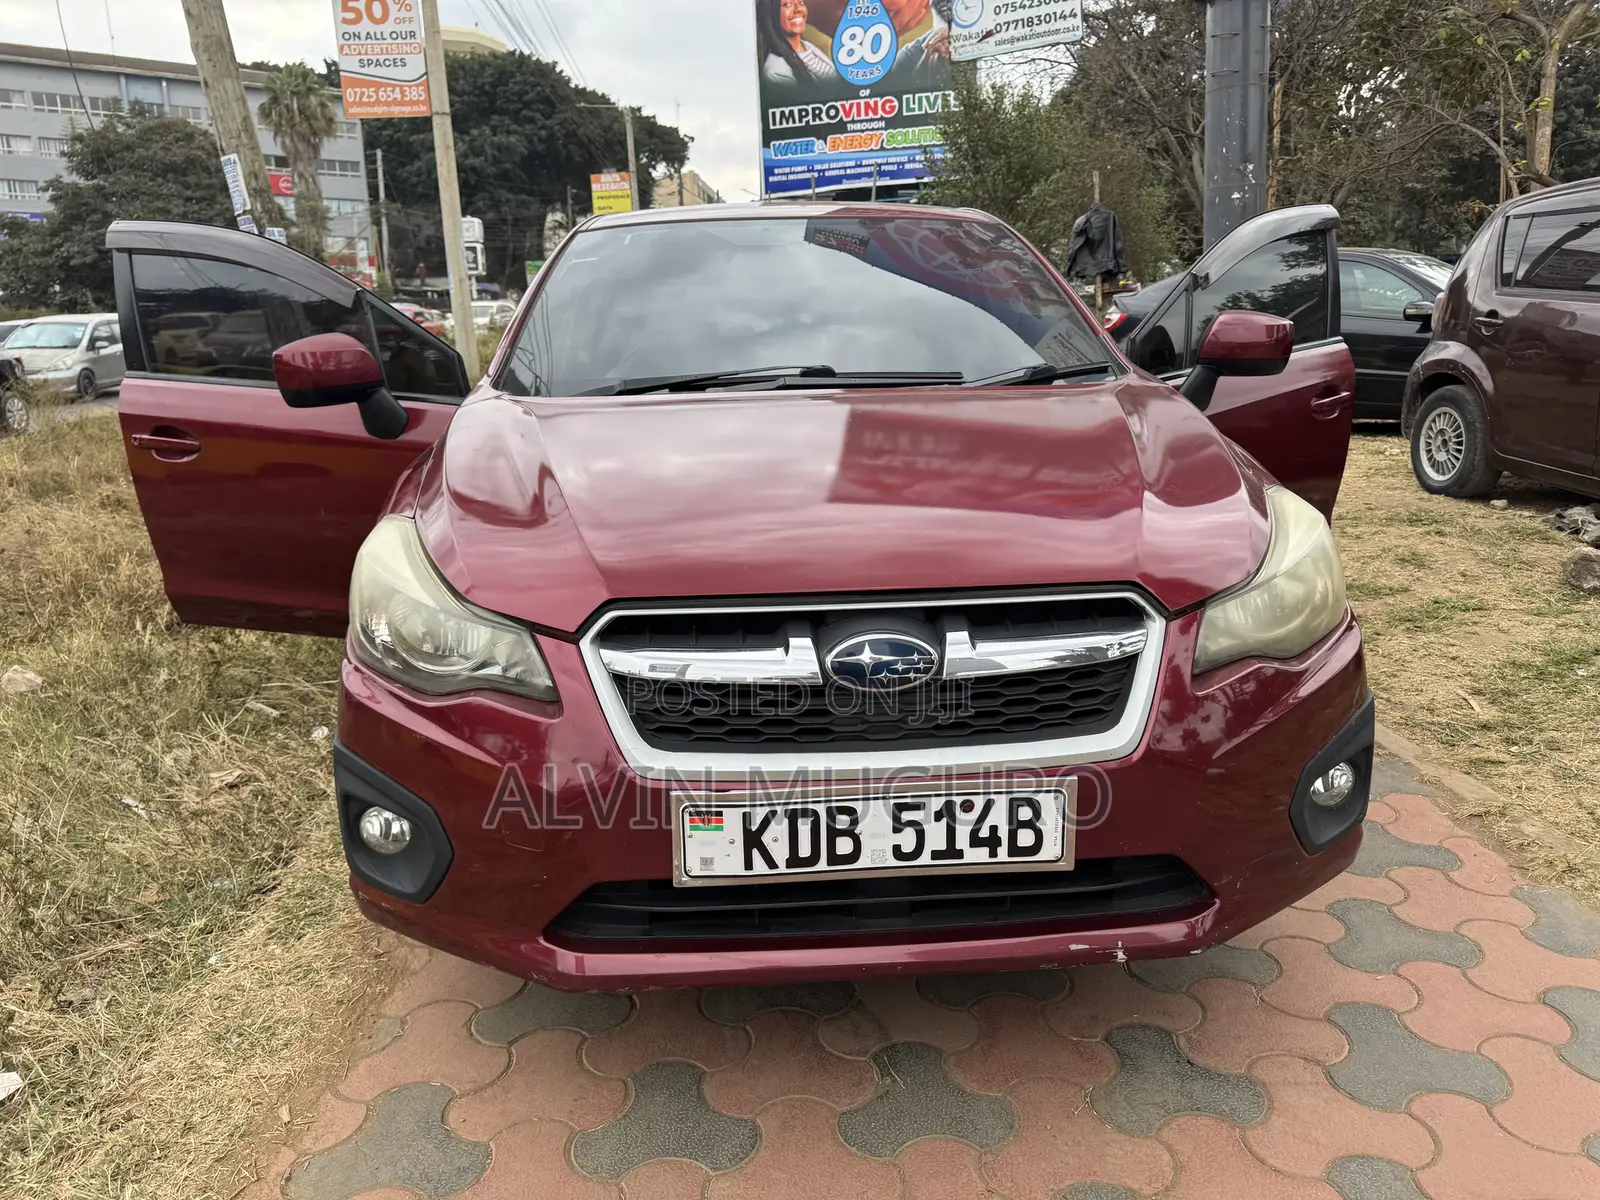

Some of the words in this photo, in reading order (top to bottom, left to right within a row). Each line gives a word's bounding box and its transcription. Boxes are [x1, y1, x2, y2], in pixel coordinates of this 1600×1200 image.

[848, 4, 879, 18] 1946
[394, 17, 414, 25] OFF
[994, 8, 1078, 34] 0771830144
[342, 31, 361, 41] ON
[365, 31, 387, 41] ALL
[389, 30, 417, 40] OUR
[342, 43, 420, 55] ADVERTISING
[837, 22, 892, 66] 80
[358, 57, 407, 68] SPACES
[848, 66, 883, 79] YEARS
[346, 87, 377, 102] 0725
[378, 86, 402, 102] 654
[403, 86, 426, 101] 385
[859, 88, 870, 97] OF
[769, 97, 898, 129] IMPROVING
[903, 91, 963, 115] LIVE
[846, 121, 886, 131] THROUGH
[772, 138, 816, 158] WATER
[827, 132, 884, 153] ENERGY
[884, 127, 949, 147] SOLUTIO
[742, 805, 862, 871] KDB
[892, 797, 1043, 862] 514B
